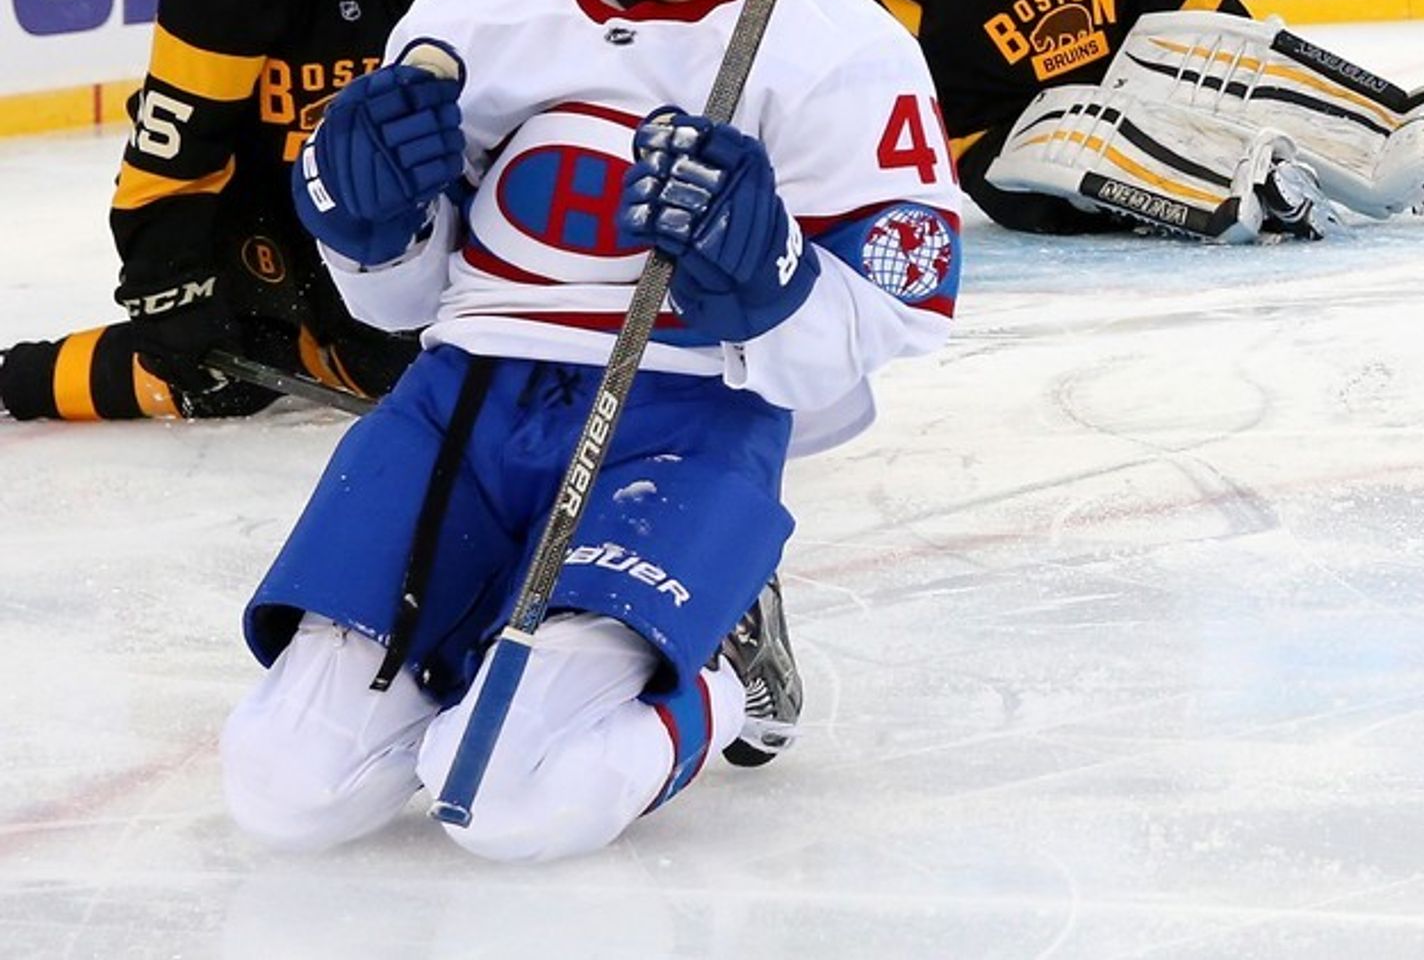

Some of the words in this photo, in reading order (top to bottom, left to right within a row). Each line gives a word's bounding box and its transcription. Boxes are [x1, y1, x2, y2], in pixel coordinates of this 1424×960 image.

[1042, 40, 1099, 74] BRUINS
[561, 390, 620, 518] BAUER
[564, 544, 691, 608] AUER
